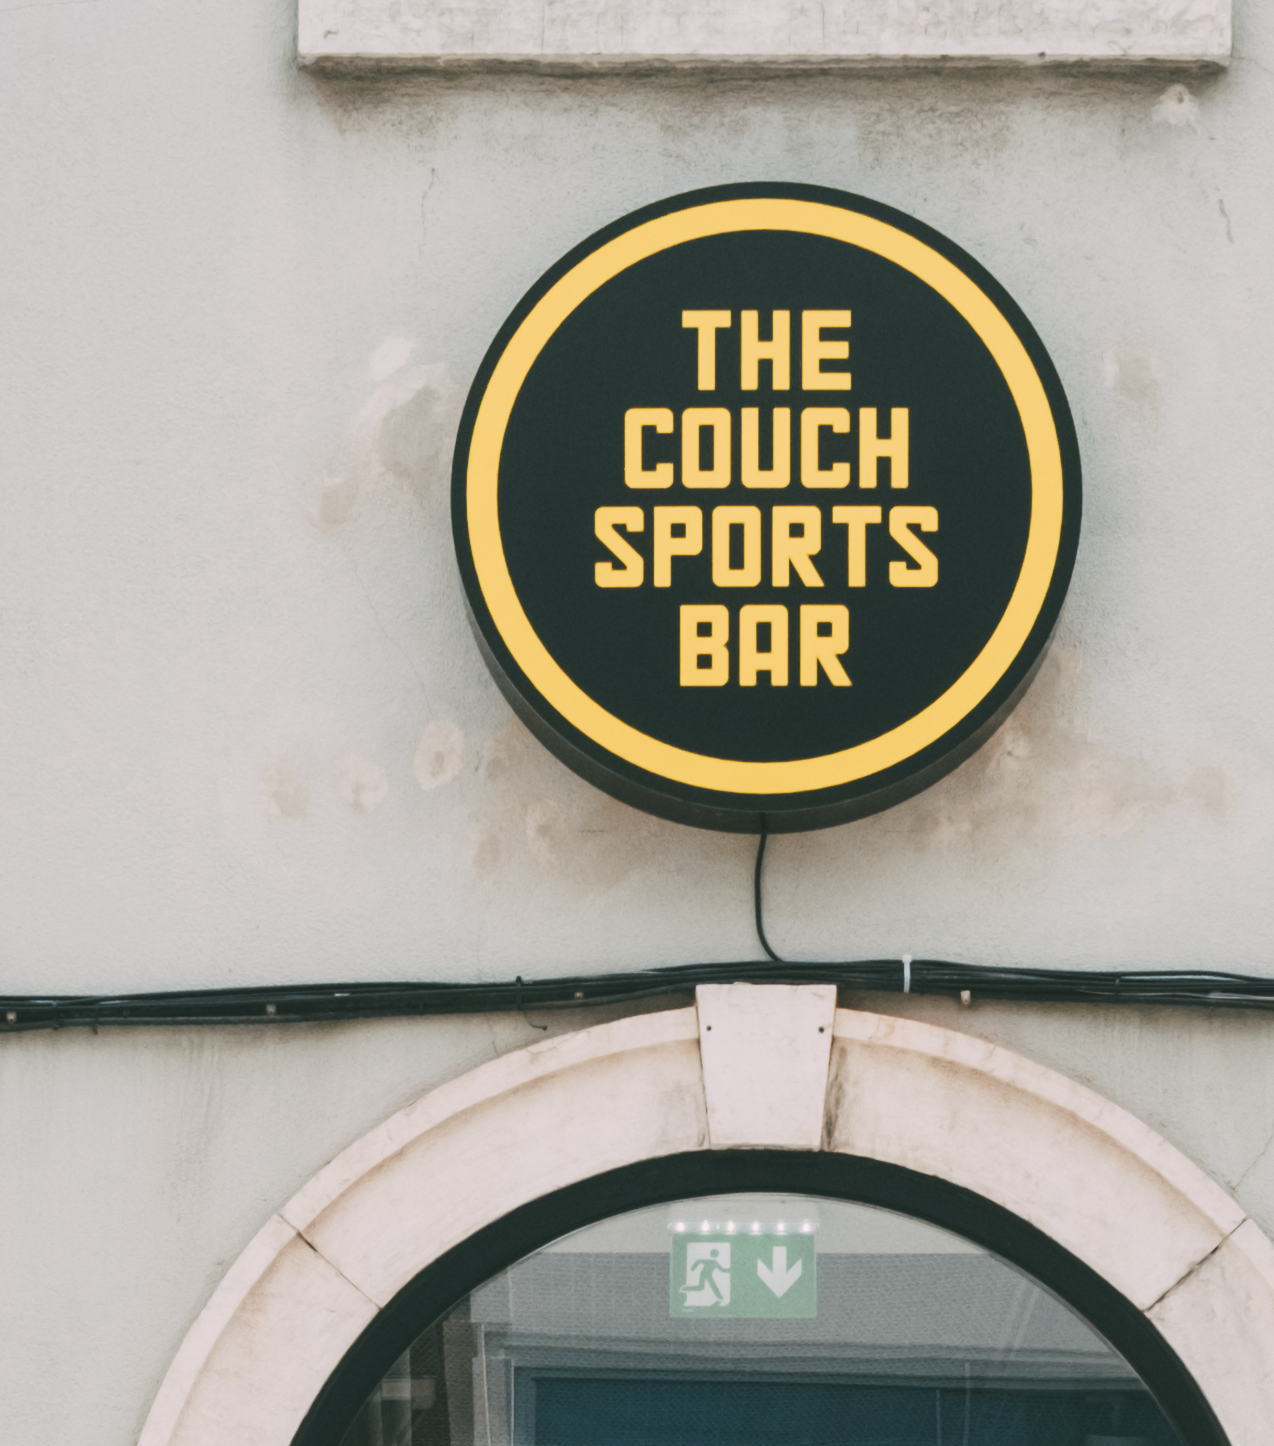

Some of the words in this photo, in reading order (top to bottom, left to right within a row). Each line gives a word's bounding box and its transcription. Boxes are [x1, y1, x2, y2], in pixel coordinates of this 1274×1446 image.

[682, 309, 852, 391] THE
[623, 407, 910, 489] COUCH
[594, 505, 939, 588] SPORTS
[679, 604, 853, 687] BAR
